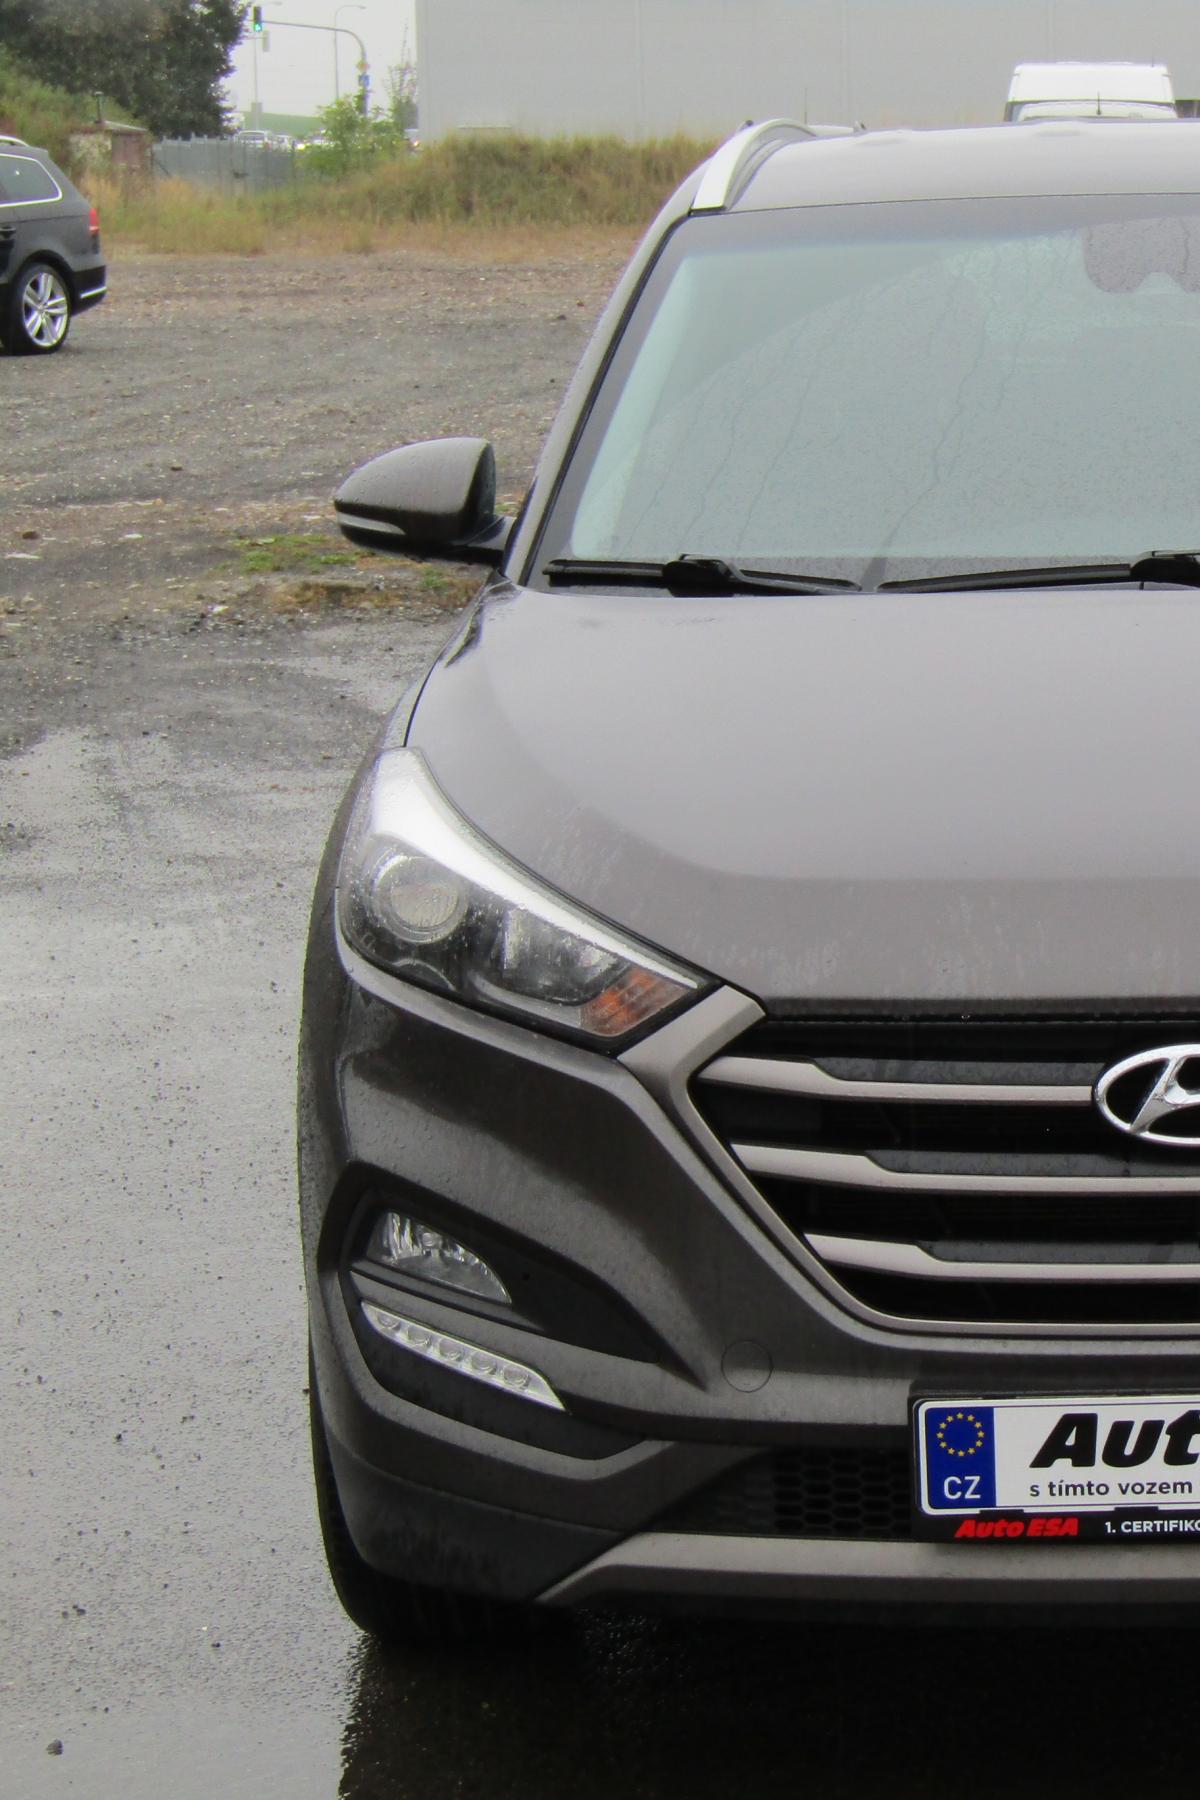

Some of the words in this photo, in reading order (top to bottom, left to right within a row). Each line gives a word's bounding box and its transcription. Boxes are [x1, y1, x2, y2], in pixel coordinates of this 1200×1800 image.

[943, 1476, 981, 1500] CZ
[1029, 1483, 1040, 1497] s
[1048, 1479, 1110, 1497] tímto
[1118, 1480, 1193, 1495] vozem
[955, 1518, 1025, 1538] Auto
[1026, 1517, 1079, 1537] ESA
[1105, 1521, 1117, 1534] 1.
